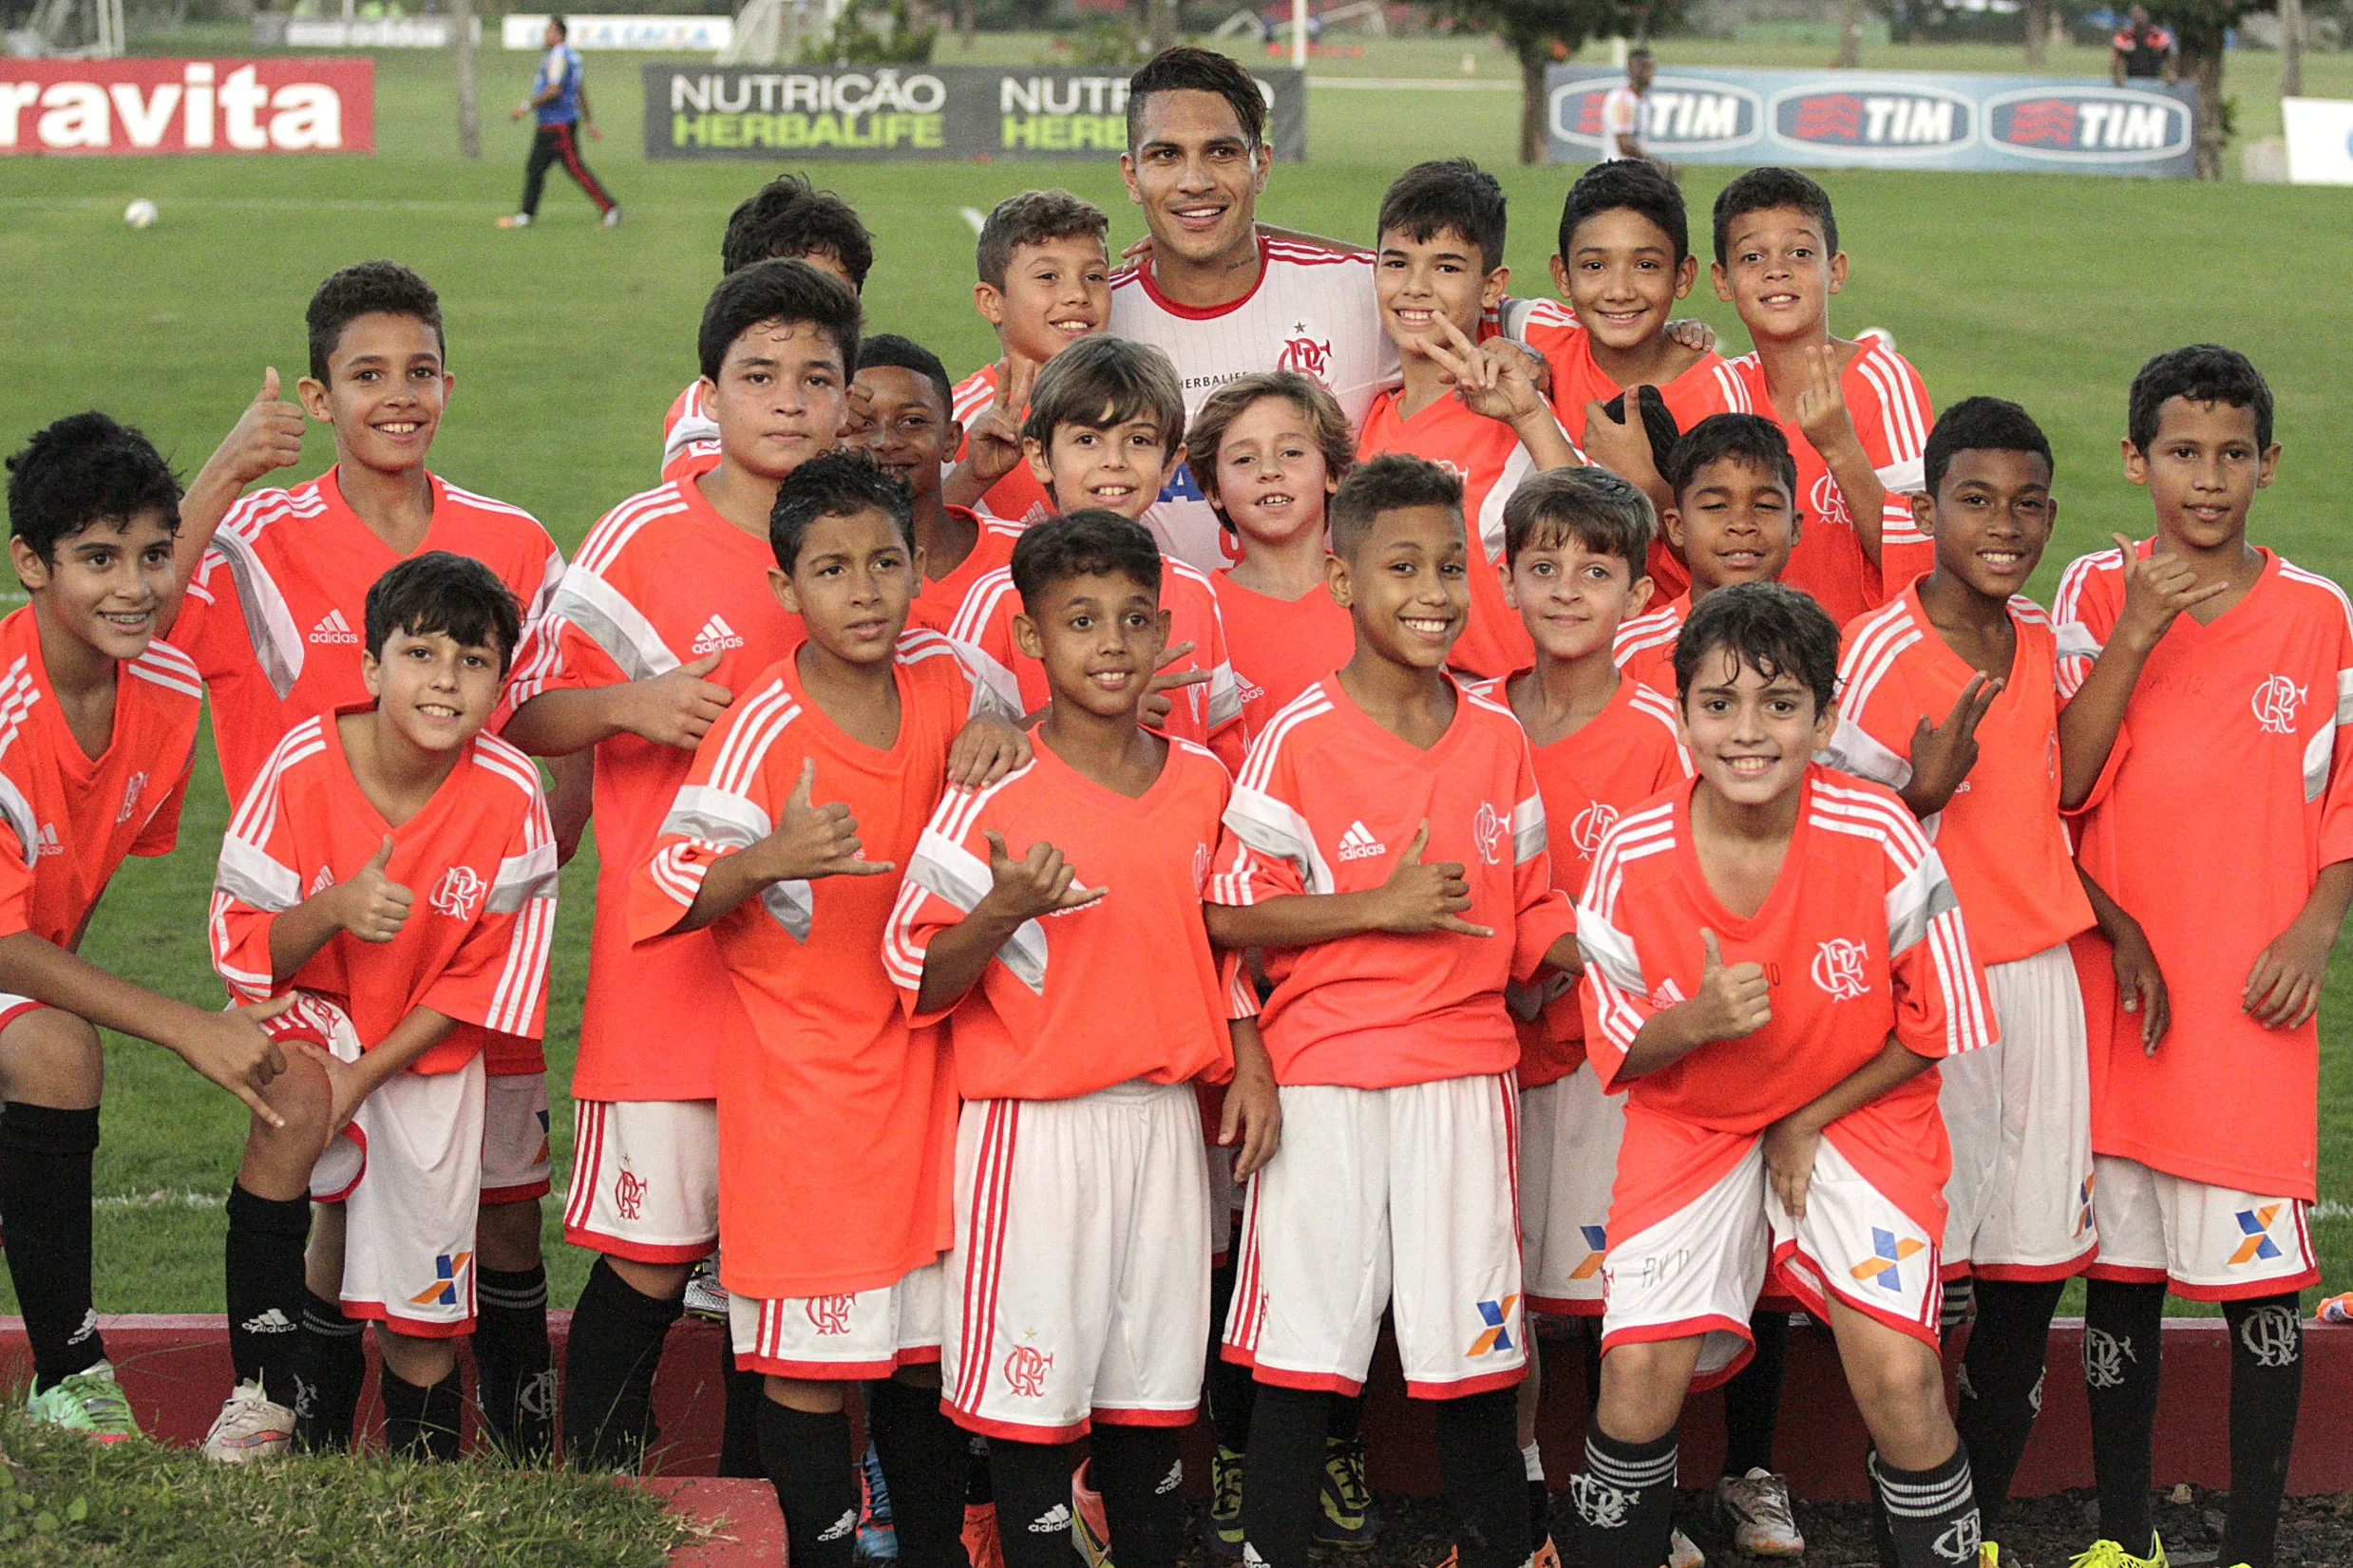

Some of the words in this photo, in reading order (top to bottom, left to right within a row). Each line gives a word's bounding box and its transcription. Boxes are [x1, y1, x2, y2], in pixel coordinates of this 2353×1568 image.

[671, 68, 947, 116] NUTRIÇÃO
[672, 112, 945, 148] HERBALIFE
[1649, 96, 1740, 139] TIM
[1864, 97, 1955, 144] TIM
[2078, 102, 2169, 148] TIM
[1178, 371, 1248, 389] HERBALIF
[308, 629, 358, 644] adidas
[692, 635, 744, 654] adidas
[1338, 841, 1386, 862] adidas
